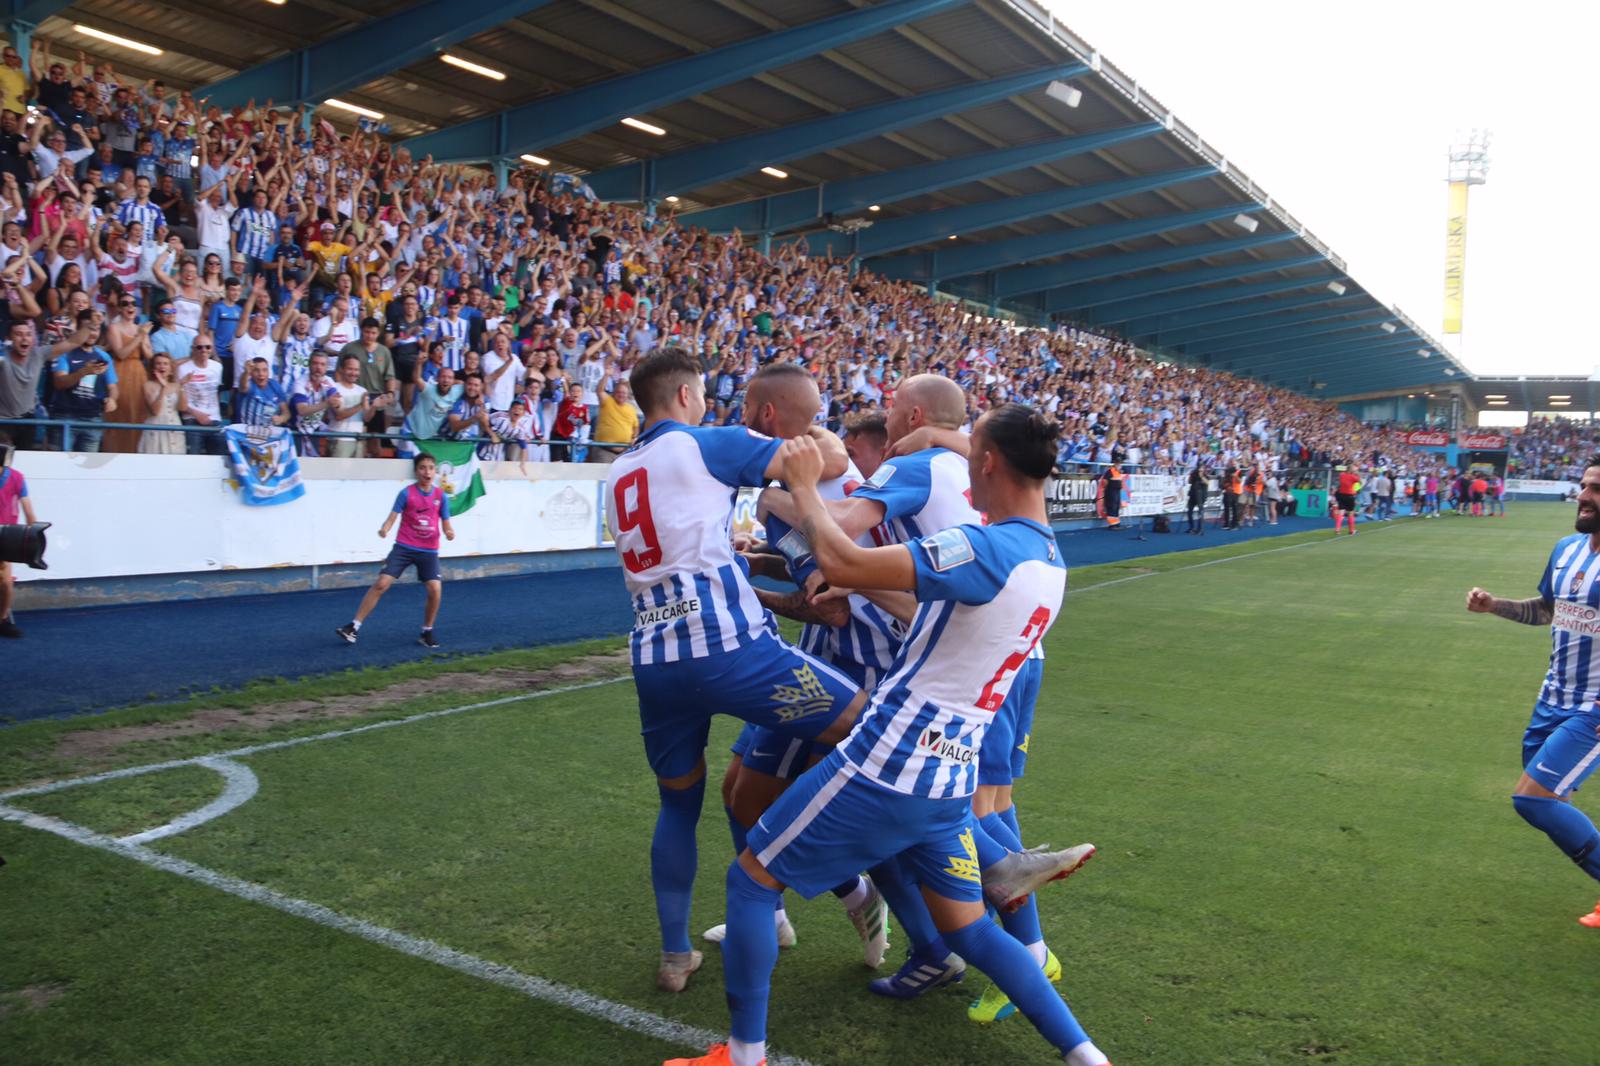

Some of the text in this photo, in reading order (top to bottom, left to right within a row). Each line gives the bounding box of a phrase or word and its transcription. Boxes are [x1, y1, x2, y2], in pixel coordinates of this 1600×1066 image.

[1446, 215, 1464, 301] ALIMERKA
[614, 467, 662, 573] 9
[640, 599, 699, 626] VALCARCE
[975, 606, 1051, 712] 2
[941, 742, 978, 763] VALCA
